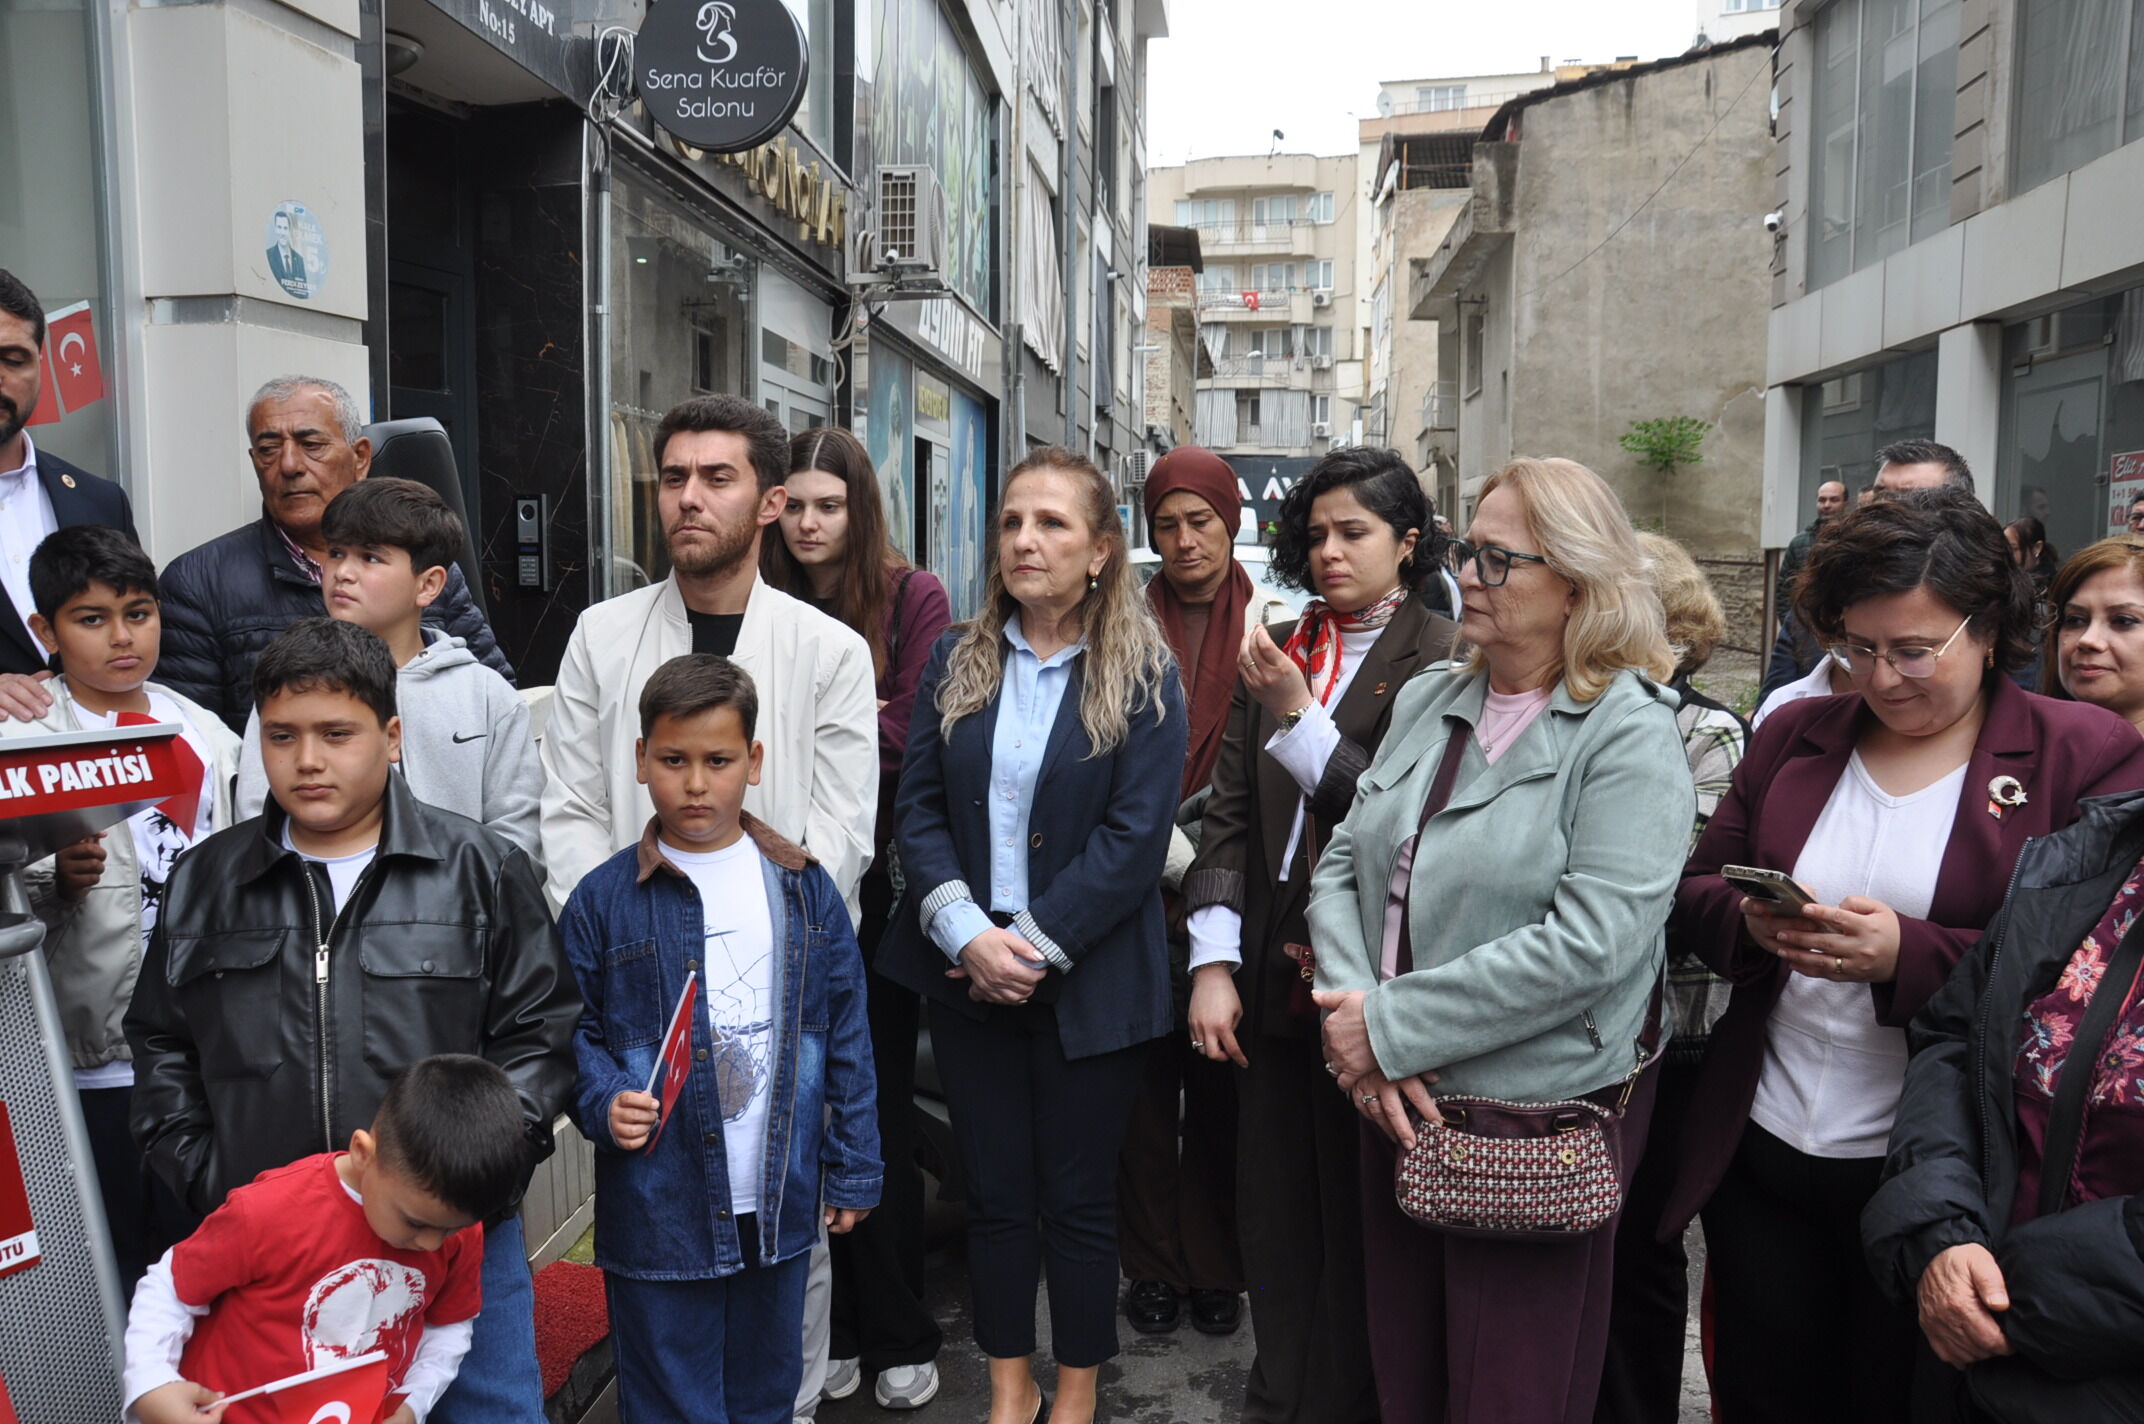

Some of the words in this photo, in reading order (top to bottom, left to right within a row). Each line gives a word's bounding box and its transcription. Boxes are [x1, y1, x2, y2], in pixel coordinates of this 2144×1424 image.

[479, 0, 516, 45] No:15
[529, 0, 555, 37] APT
[646, 68, 702, 89] Sena
[711, 66, 787, 88] Kuaför
[676, 96, 755, 118] Salonu
[37, 745, 154, 795] PARTİSİ
[0, 1238, 24, 1263] TÜ
